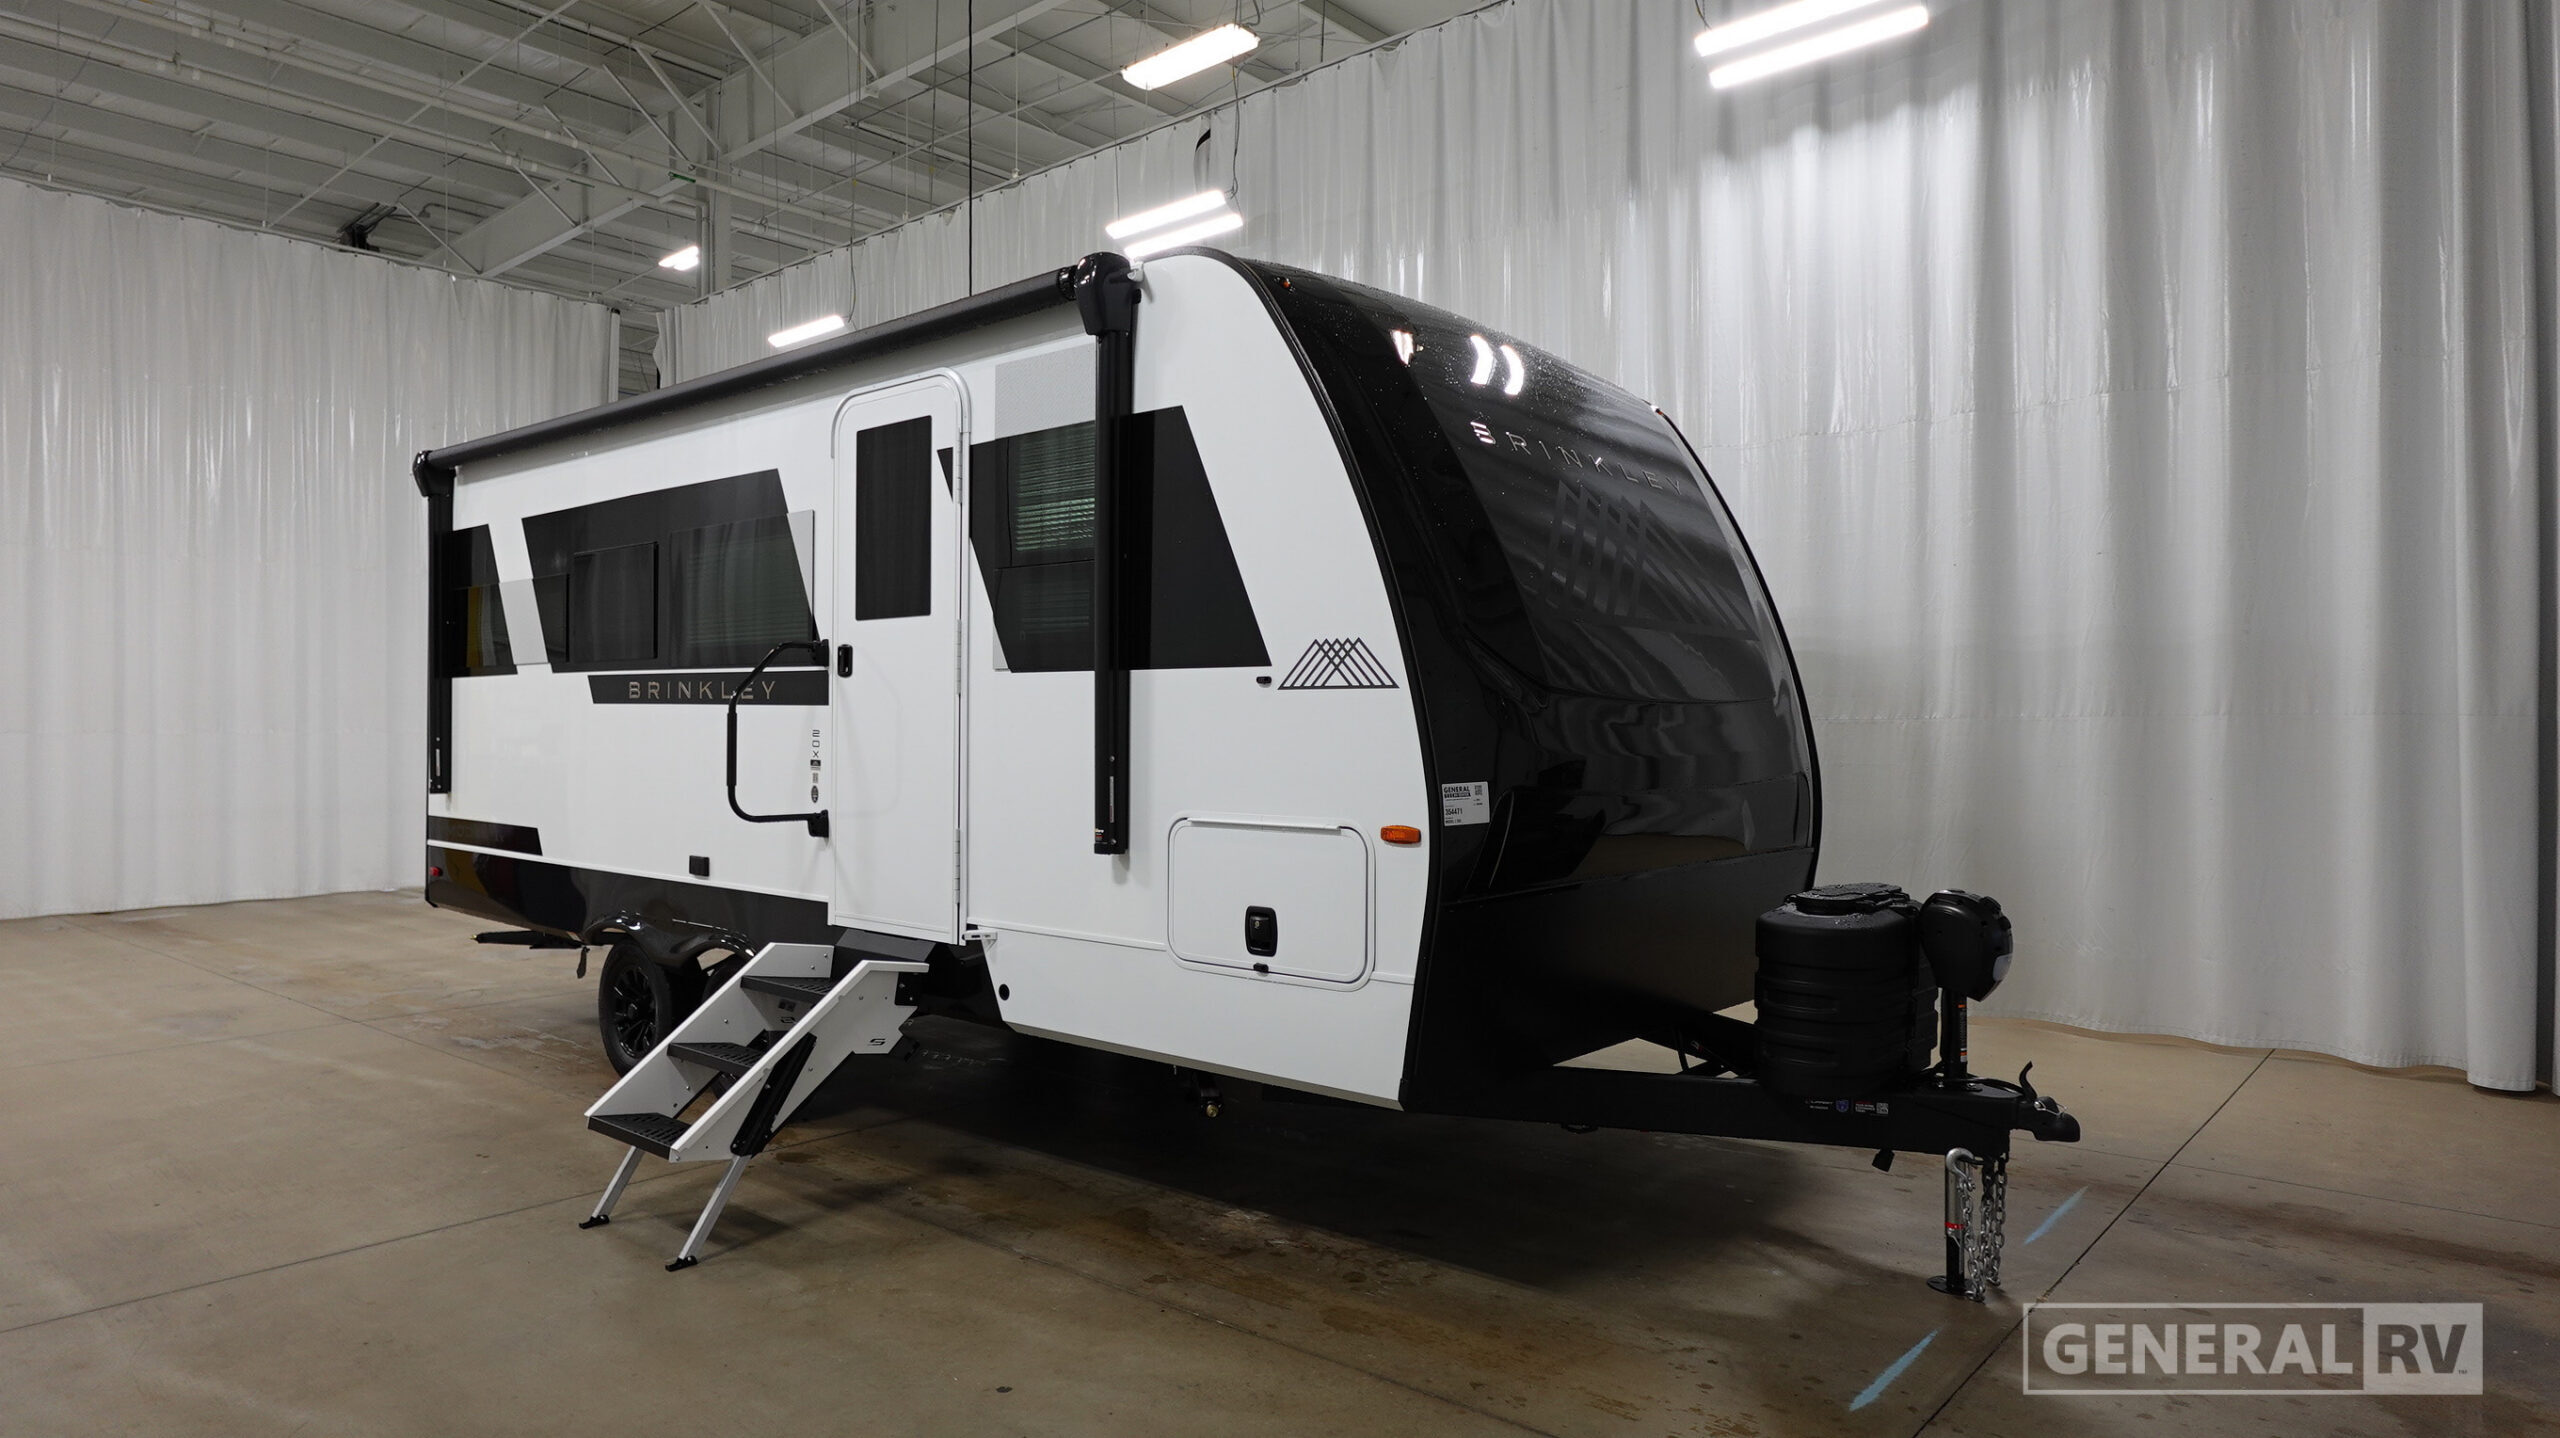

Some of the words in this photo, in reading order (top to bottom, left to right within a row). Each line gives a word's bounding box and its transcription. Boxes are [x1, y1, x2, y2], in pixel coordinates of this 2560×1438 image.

[1470, 420, 1682, 495] BRINKLEY
[628, 680, 777, 700] BRINKLEY
[1445, 808, 1463, 816] 354471
